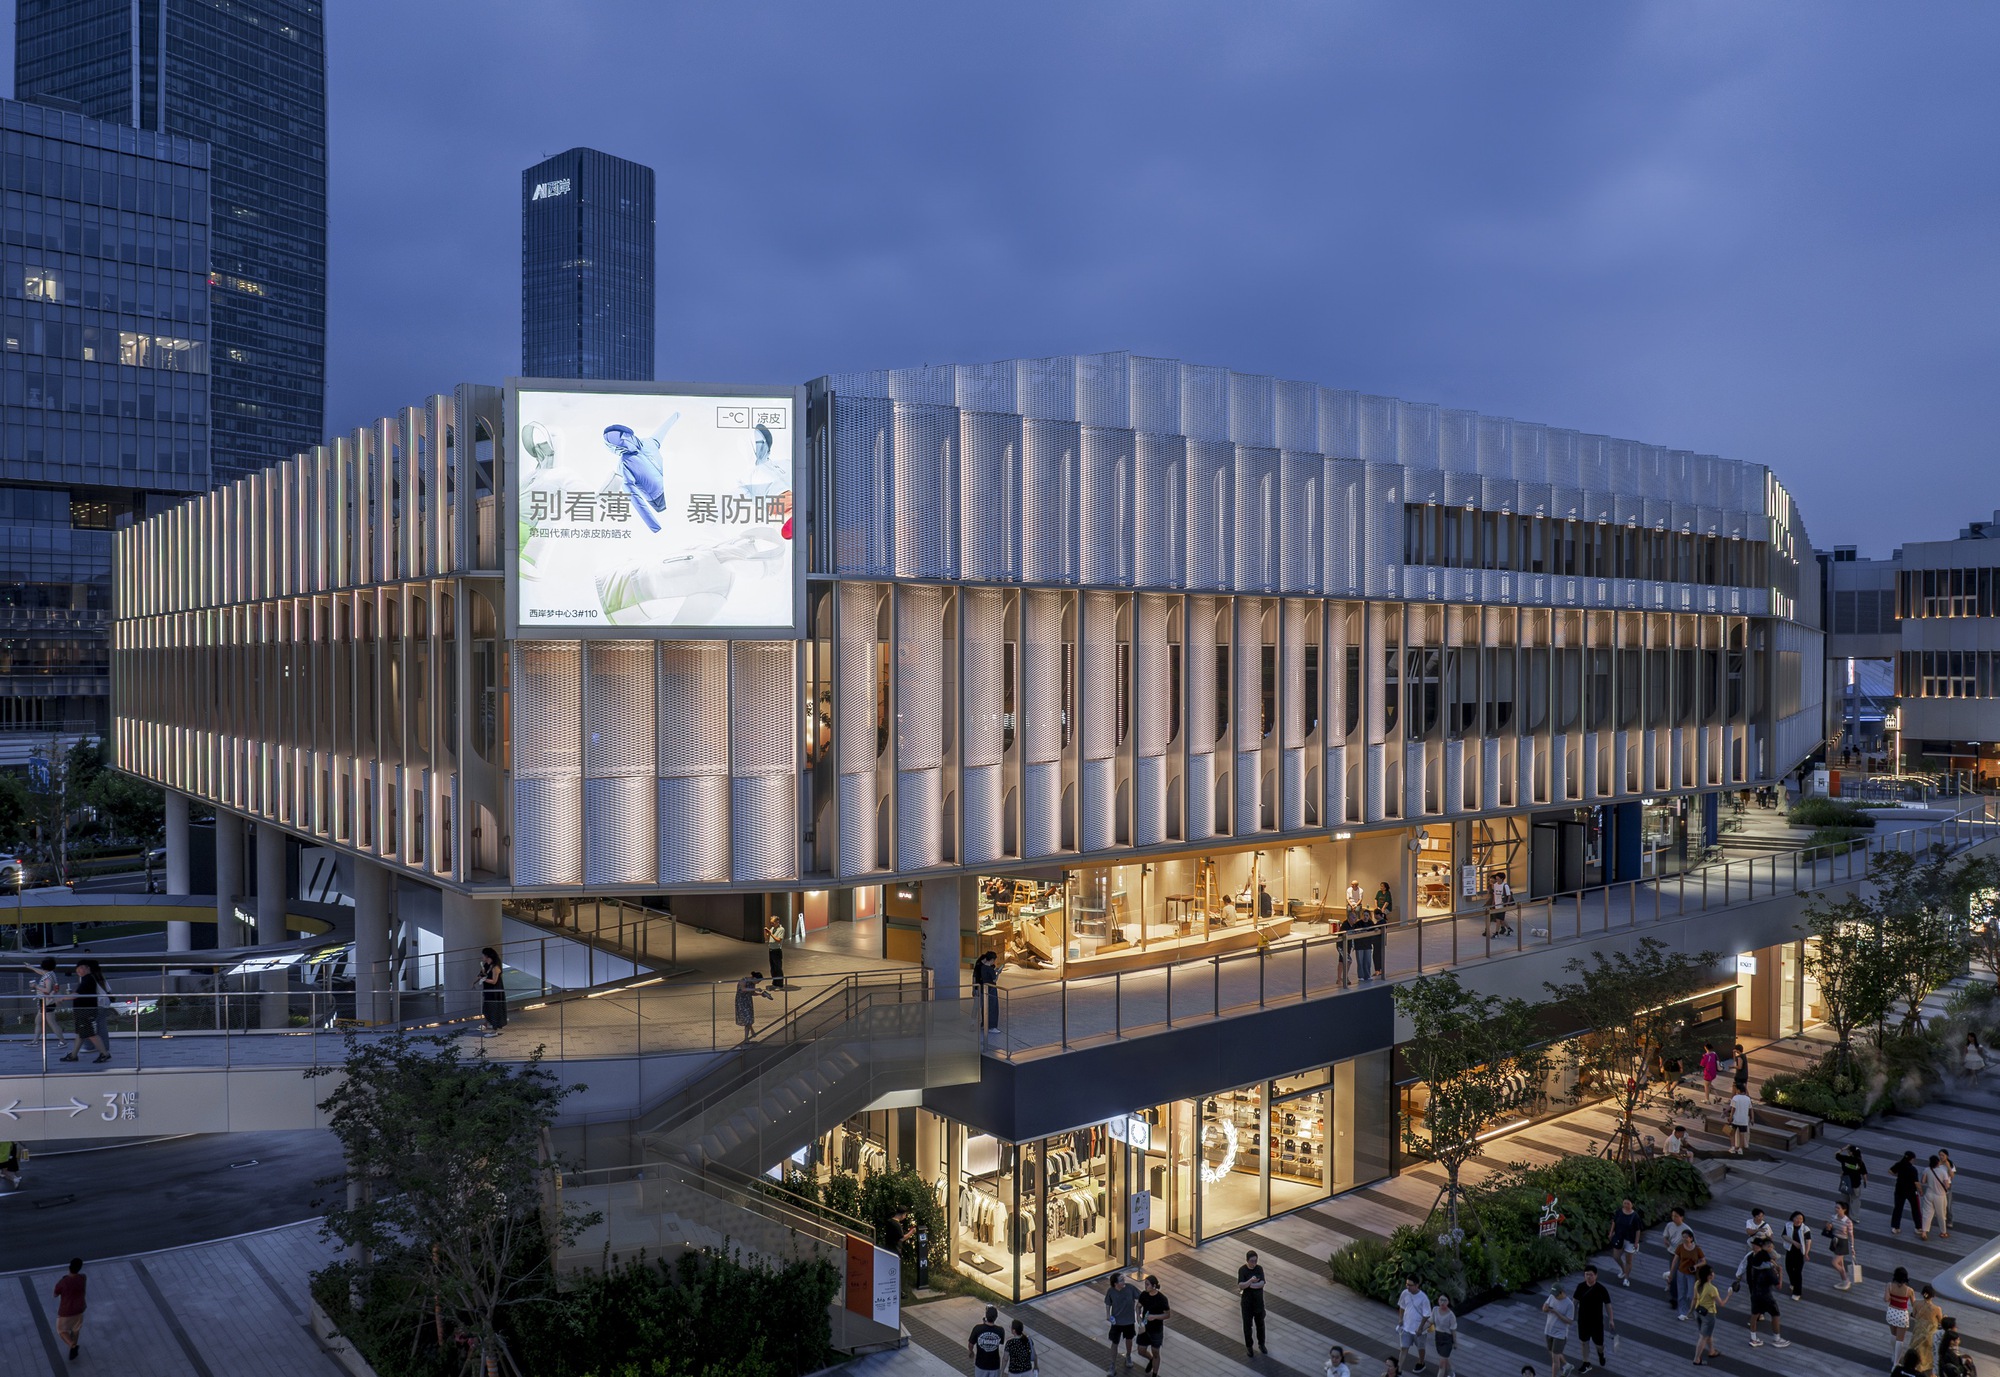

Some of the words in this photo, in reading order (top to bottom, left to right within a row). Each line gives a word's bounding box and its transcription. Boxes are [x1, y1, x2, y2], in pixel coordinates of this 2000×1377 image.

[757, 413, 780, 424] 凉皮
[529, 490, 632, 523] 别看薄
[686, 494, 785, 524] 暴防晒
[529, 528, 632, 539] 第四代蕉内凉皮防晒衣
[529, 609, 598, 618] 西岸梦中心3#110
[102, 1094, 118, 1121] 3
[121, 1107, 136, 1120] 栋
